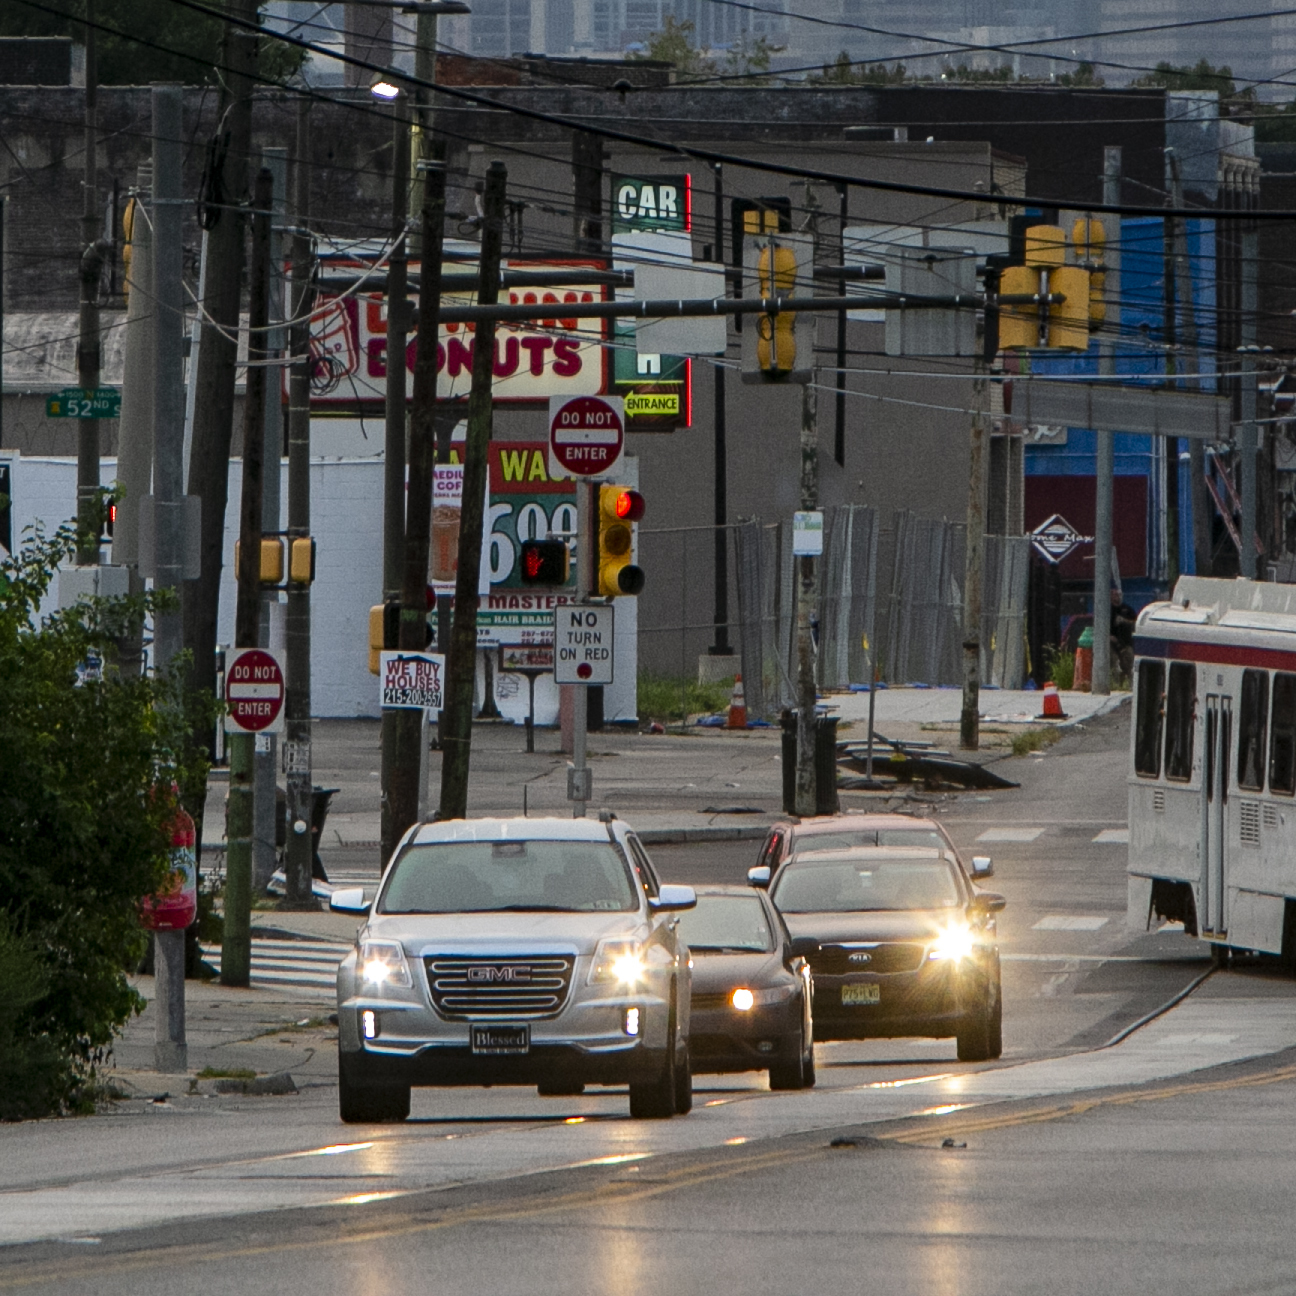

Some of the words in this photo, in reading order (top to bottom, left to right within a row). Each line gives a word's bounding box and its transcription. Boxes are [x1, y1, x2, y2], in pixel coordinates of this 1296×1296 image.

[618, 186, 678, 219] CAR
[626, 395, 678, 410] ENTRANCE
[561, 413, 581, 425] DO
[585, 412, 613, 424] NOT
[566, 447, 608, 460] ENTER
[500, 449, 577, 482] WA
[436, 481, 462, 491] COF
[570, 611, 598, 628] NO
[567, 632, 602, 646] TURN
[560, 648, 577, 660] ON
[584, 648, 609, 660] RED
[235, 666, 249, 679] DO
[254, 666, 276, 679] NOT
[387, 661, 410, 675] WE
[416, 661, 440, 678] BUY
[385, 674, 441, 691] HOUSES
[238, 703, 271, 715] ENTER
[468, 966, 531, 981] GMC
[476, 1032, 525, 1046] Blessed
